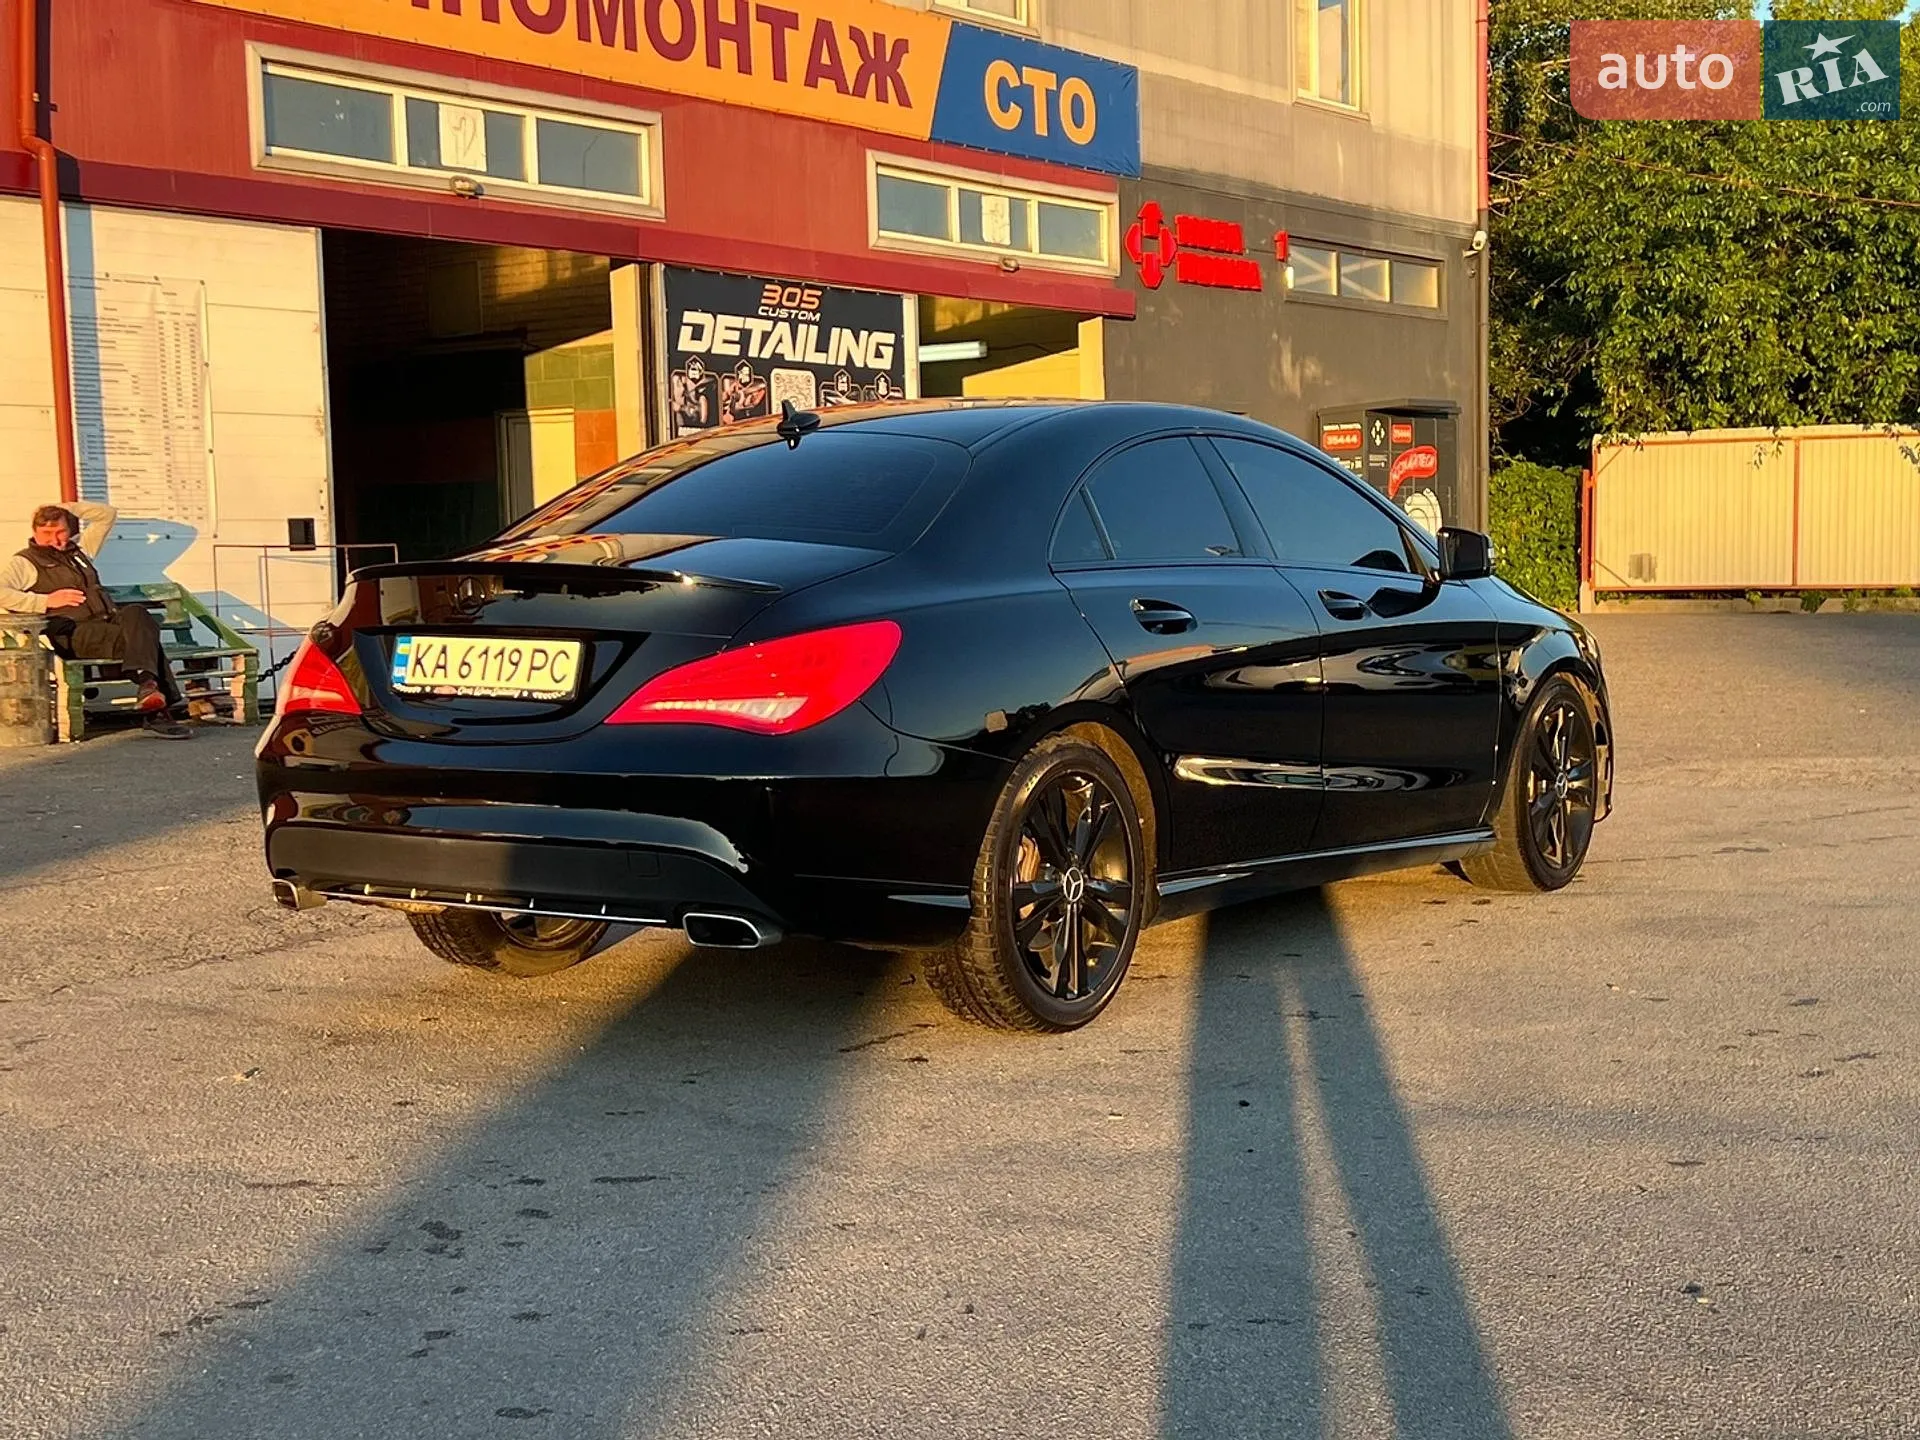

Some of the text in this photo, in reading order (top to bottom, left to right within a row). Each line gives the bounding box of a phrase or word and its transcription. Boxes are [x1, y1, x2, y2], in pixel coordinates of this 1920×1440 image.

[411, 0, 912, 109] МОНТАЖ
[984, 60, 1097, 146] СТО
[758, 306, 821, 322] CUSTOM
[760, 283, 823, 310] 305
[677, 310, 896, 370] DETAILING
[412, 643, 570, 684] KA 6119 PC
